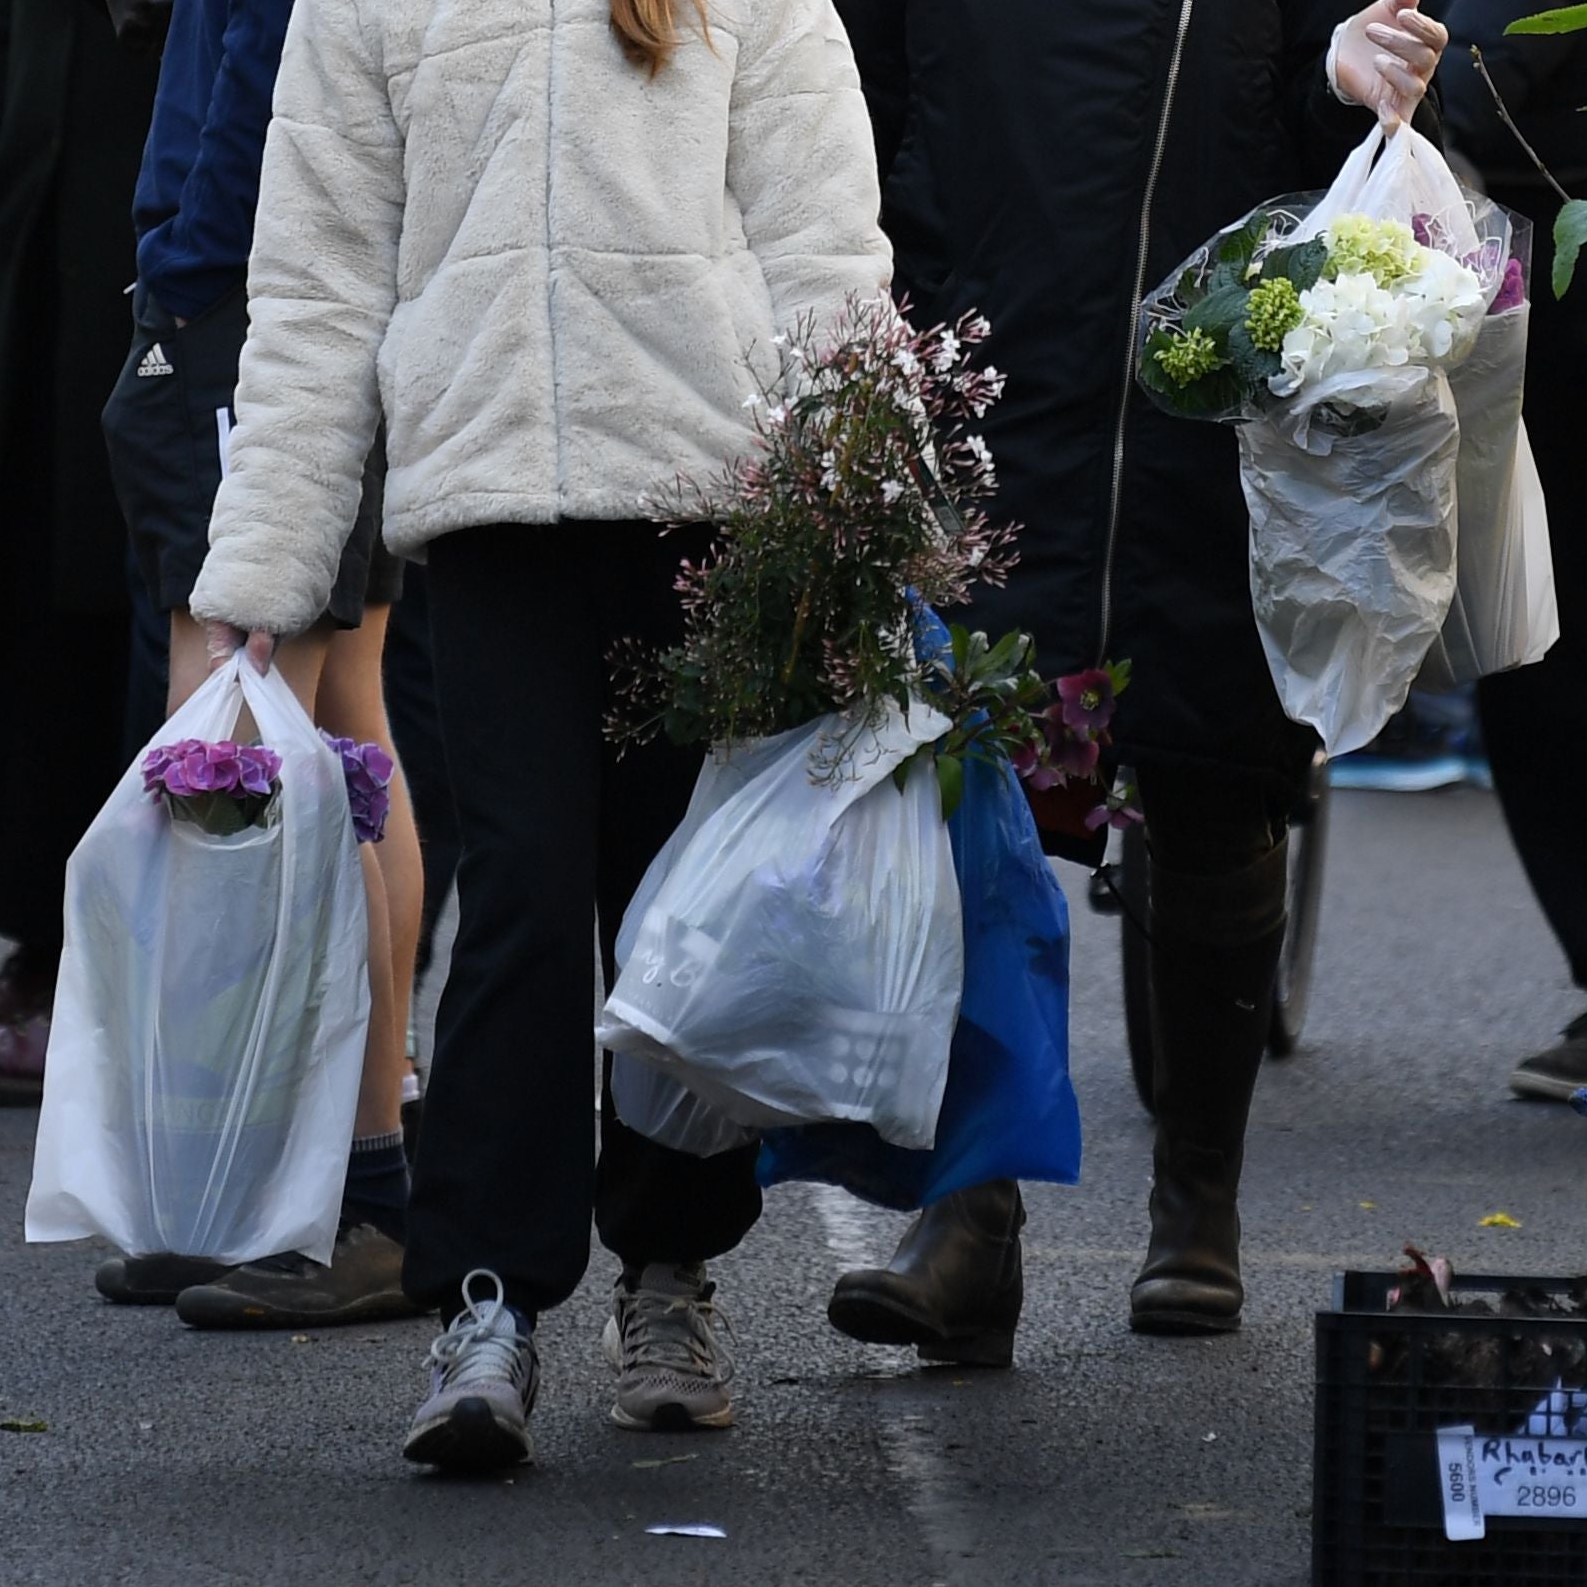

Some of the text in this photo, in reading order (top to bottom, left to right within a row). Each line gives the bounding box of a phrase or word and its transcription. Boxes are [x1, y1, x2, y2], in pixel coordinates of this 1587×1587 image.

[137, 364, 174, 377] adidas
[1449, 1462, 1465, 1502] 5600
[1517, 1486, 1577, 1507] 2896
[1470, 1484, 1481, 1527] NUMBER
